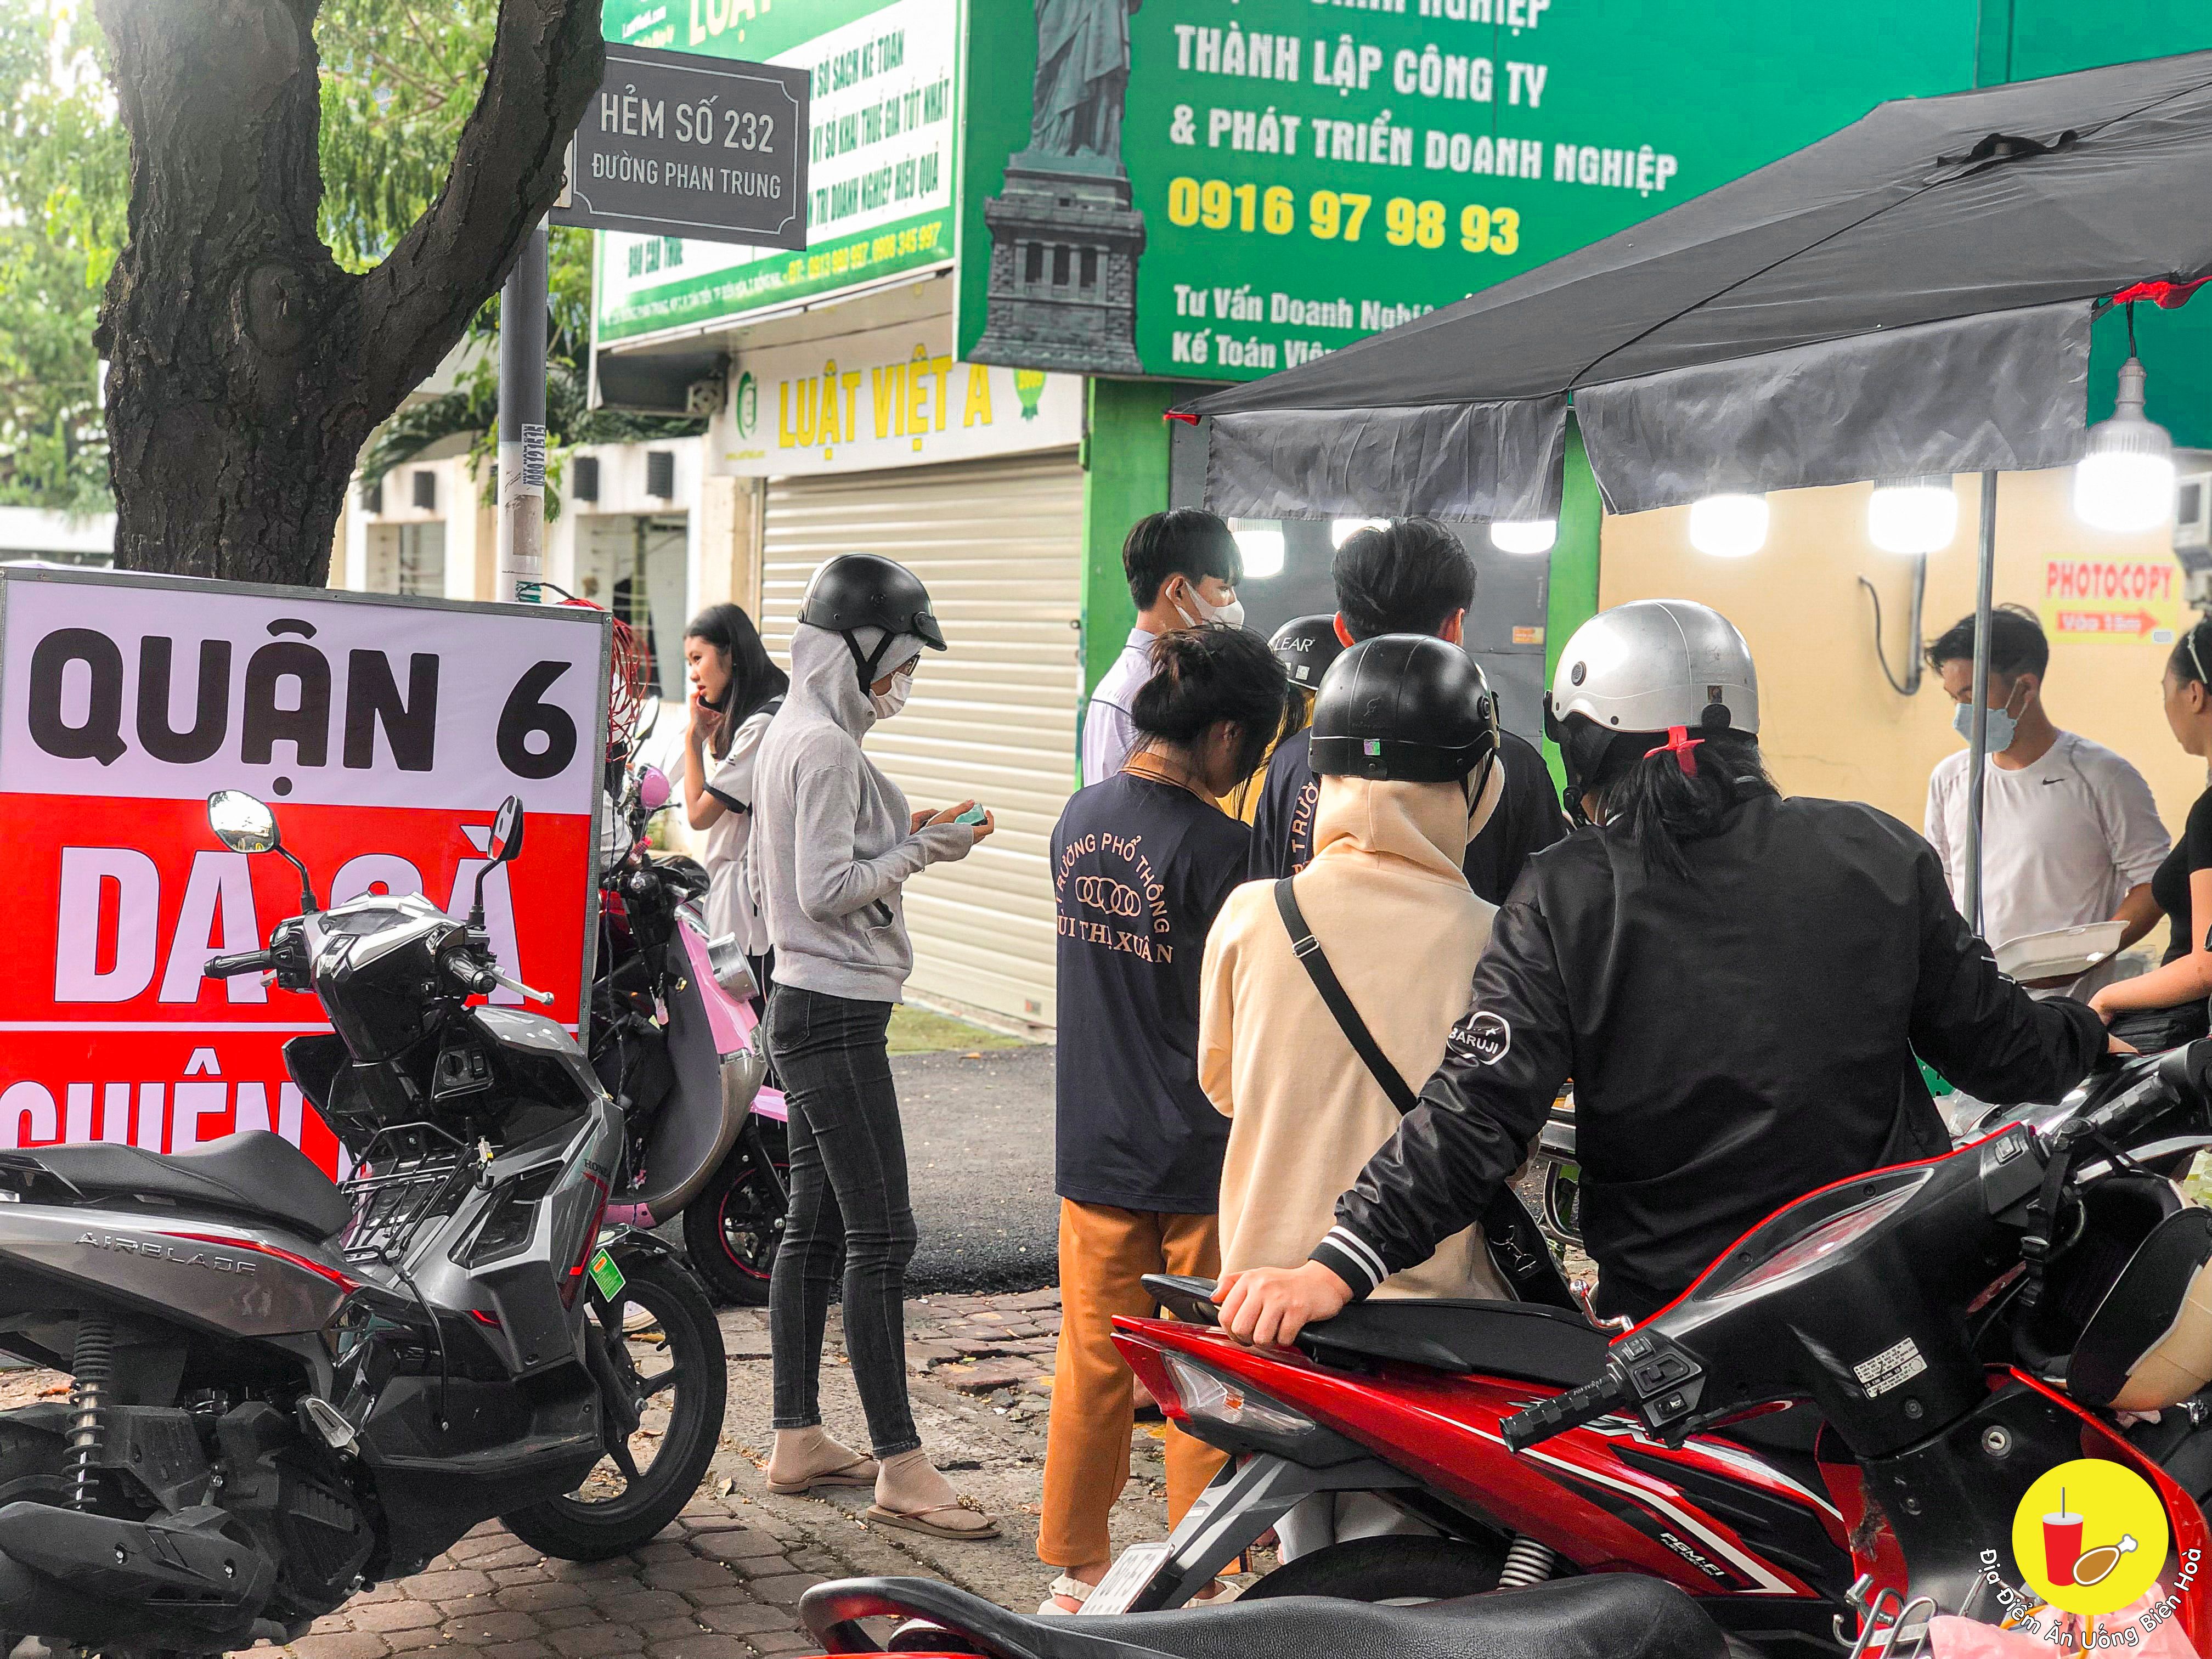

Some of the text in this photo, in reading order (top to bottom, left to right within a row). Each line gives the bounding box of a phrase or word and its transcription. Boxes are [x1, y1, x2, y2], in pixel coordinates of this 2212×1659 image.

[1174, 22, 1548, 108] THÀNH LẬP CÔNG TY
[601, 84, 775, 153] HẺM SỐ 232
[1169, 104, 1678, 198] & PHÁT TRIỂN DOANH NGHIỆP
[591, 149, 782, 200] ĐƯỜNG PHAN TRUNG
[1168, 176, 1520, 257] 0916 97 98 93
[1173, 284, 1209, 318] Tư
[1212, 284, 1263, 322] Vấn
[1270, 292, 1355, 329] Doanh
[1172, 328, 1212, 364] Kế
[1215, 336, 1277, 369] Toán
[778, 359, 861, 461] LUẬT
[872, 343, 953, 452] VIỆT
[2046, 561, 2174, 601] PHOTOCOPY
[27, 618, 578, 797] QUẬN 6
[1101, 832, 1142, 862] PHỔ
[1136, 854, 1170, 934] THÔNG
[53, 845, 268, 1005] DA
[1113, 930, 1173, 964] XUÂN
[1448, 1027, 1499, 1054] BARUJI
[1661, 1538, 1716, 1576] FUEL INJECTION
